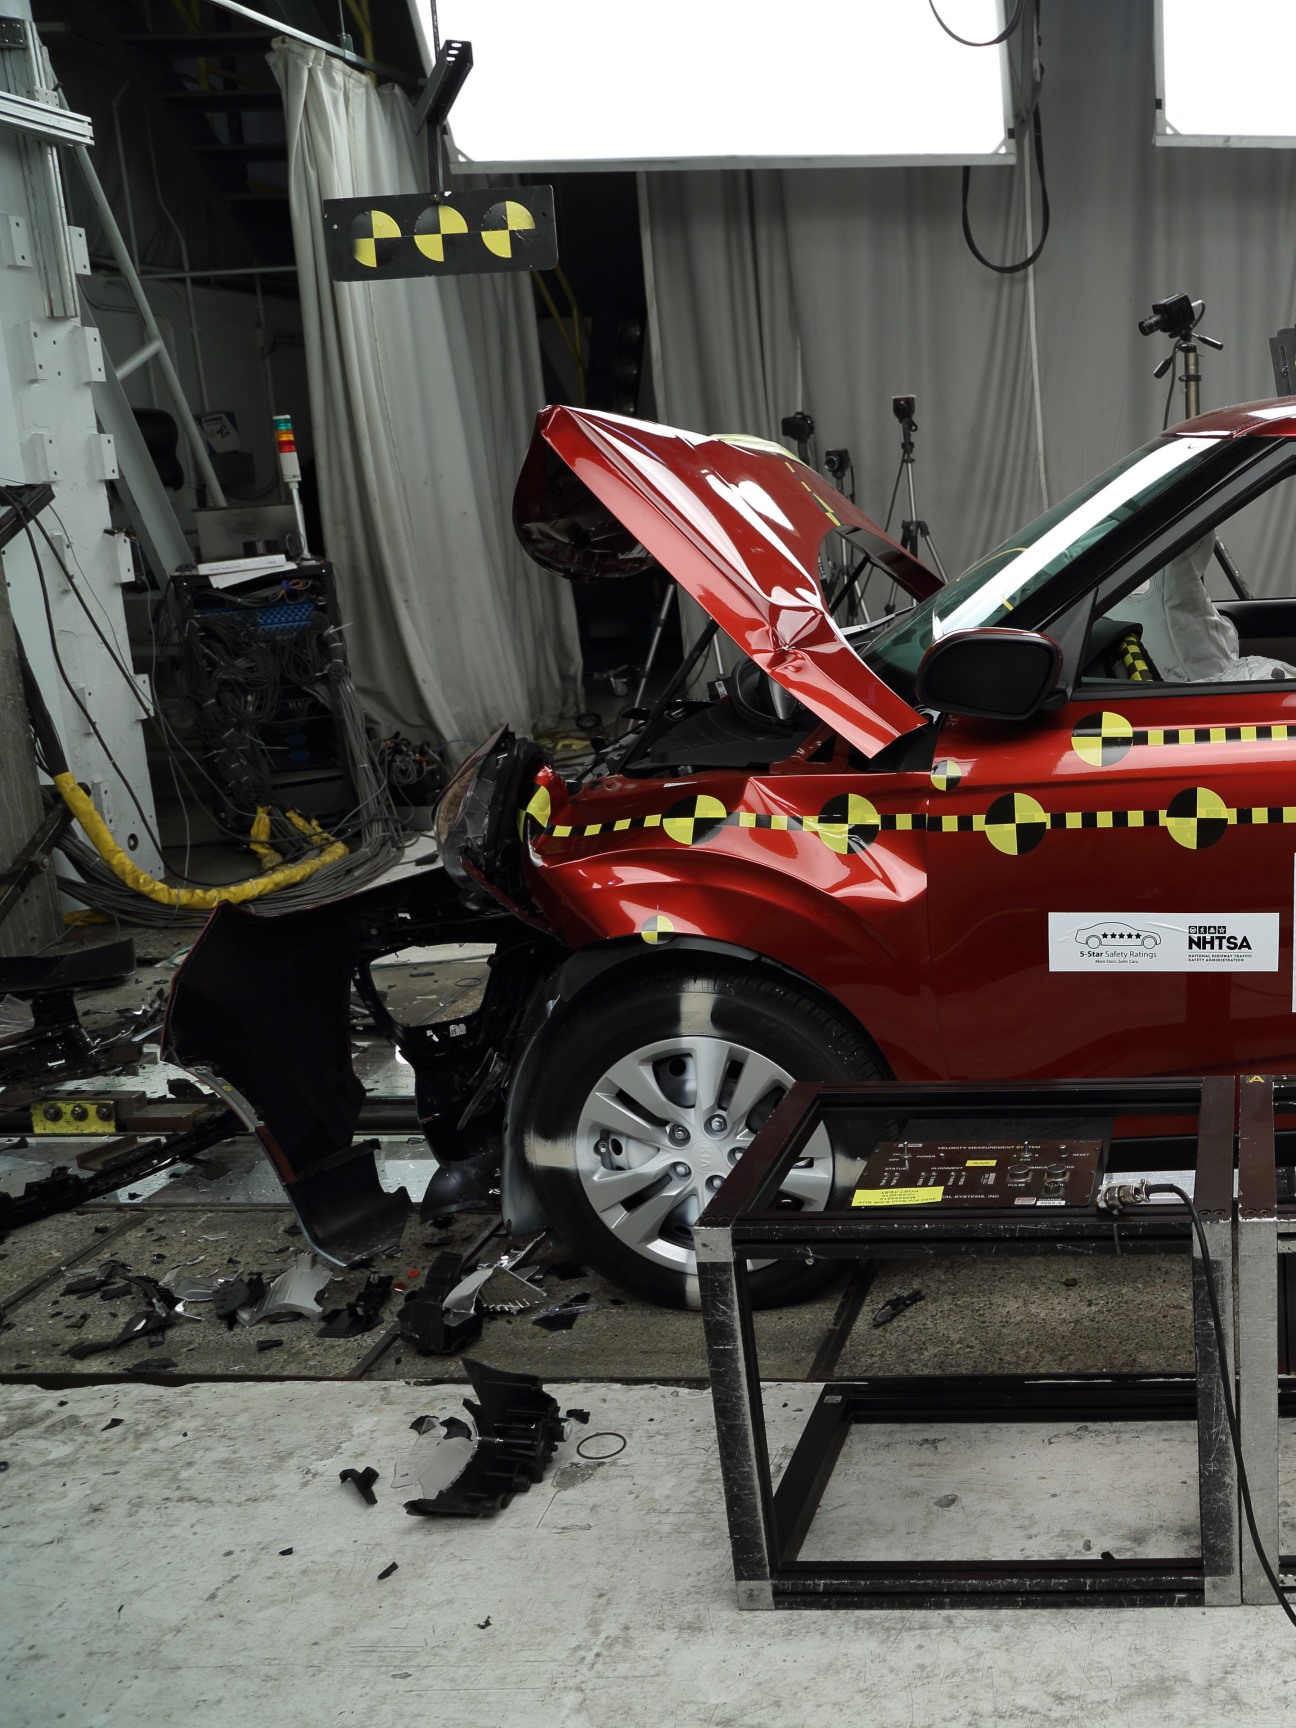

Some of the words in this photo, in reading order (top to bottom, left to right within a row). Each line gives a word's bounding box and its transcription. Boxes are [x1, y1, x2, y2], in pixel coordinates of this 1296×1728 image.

[1188, 935, 1252, 950] NHTSA
[1079, 950, 1104, 958] 5-Star
[1105, 950, 1128, 959] Safety
[1129, 951, 1157, 960] Ratings
[700, 1144, 712, 1169] KIA
